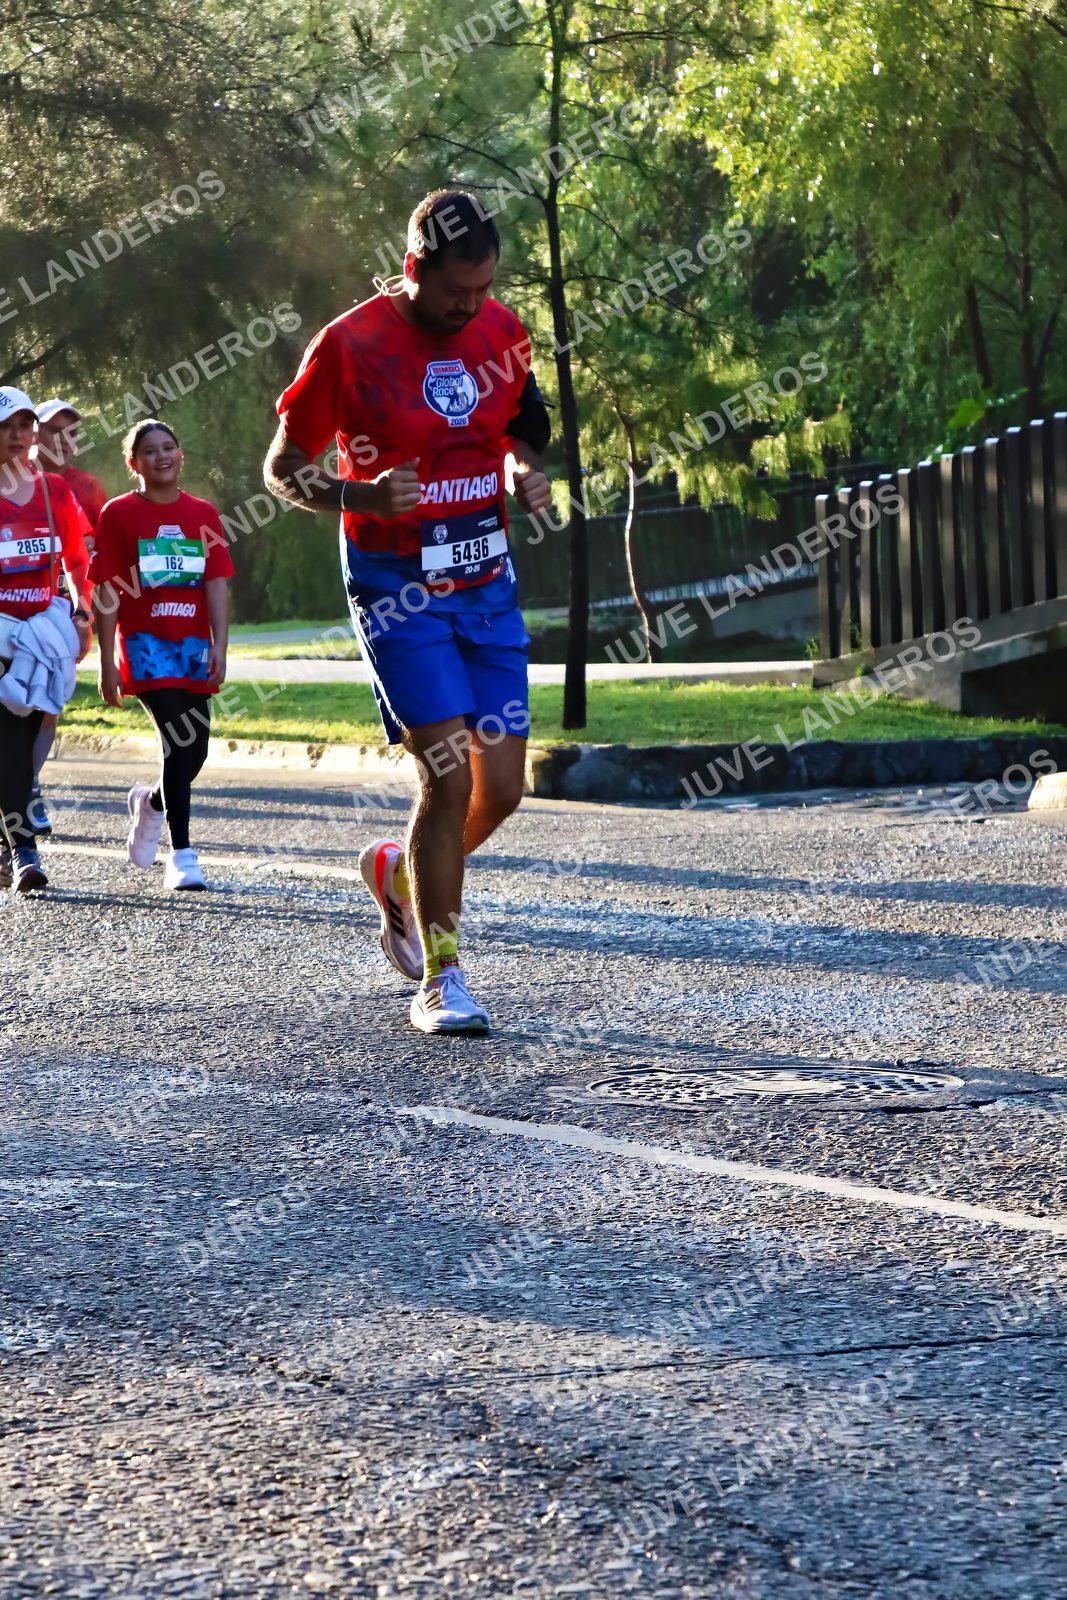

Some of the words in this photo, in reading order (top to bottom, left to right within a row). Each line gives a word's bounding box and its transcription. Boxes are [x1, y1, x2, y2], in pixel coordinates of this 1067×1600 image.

[435, 376, 464, 388] Global
[432, 387, 455, 397] Race
[450, 417, 467, 426] 2026
[17, 538, 46, 555] 2855
[452, 537, 489, 565] 5436
[165, 556, 184, 571] 162
[150, 602, 197, 618] SANTIAGO
